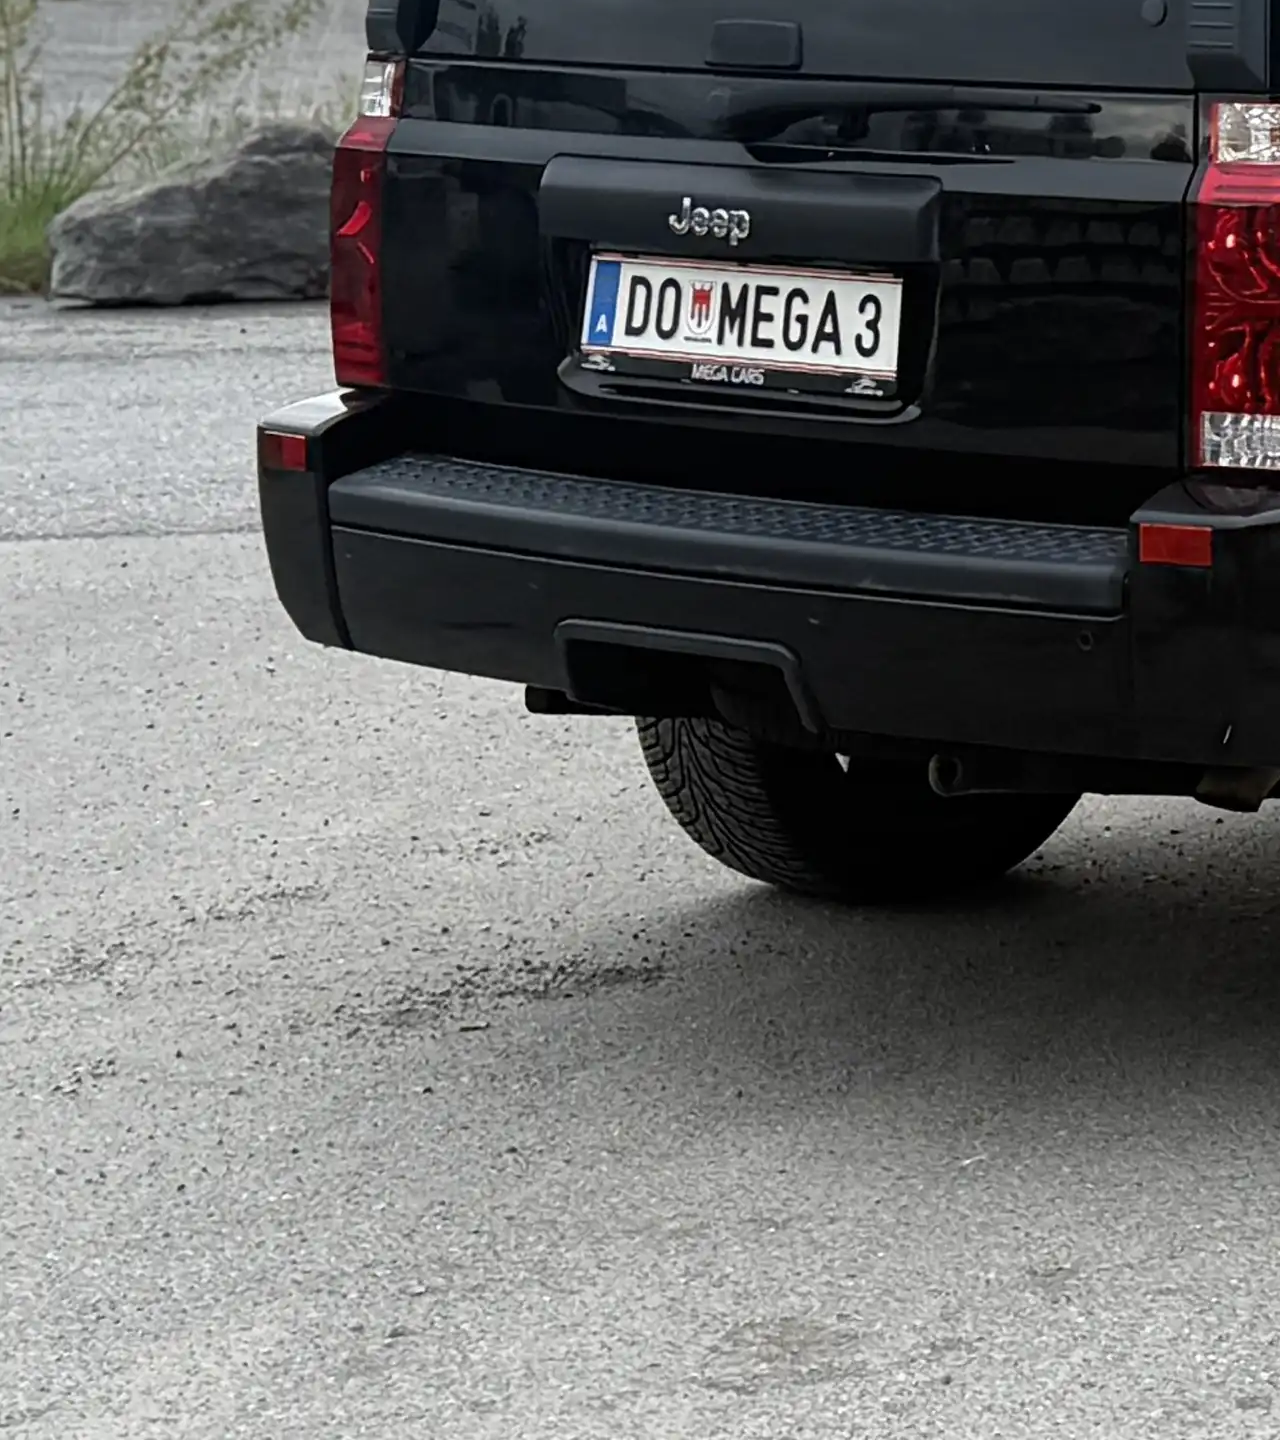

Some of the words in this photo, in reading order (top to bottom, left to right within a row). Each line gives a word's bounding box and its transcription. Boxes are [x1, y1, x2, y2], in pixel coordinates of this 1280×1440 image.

[668, 197, 750, 245] Jeep
[595, 312, 608, 334] A
[624, 275, 682, 340] DO
[716, 282, 841, 356] MEGA
[854, 294, 882, 357] 3
